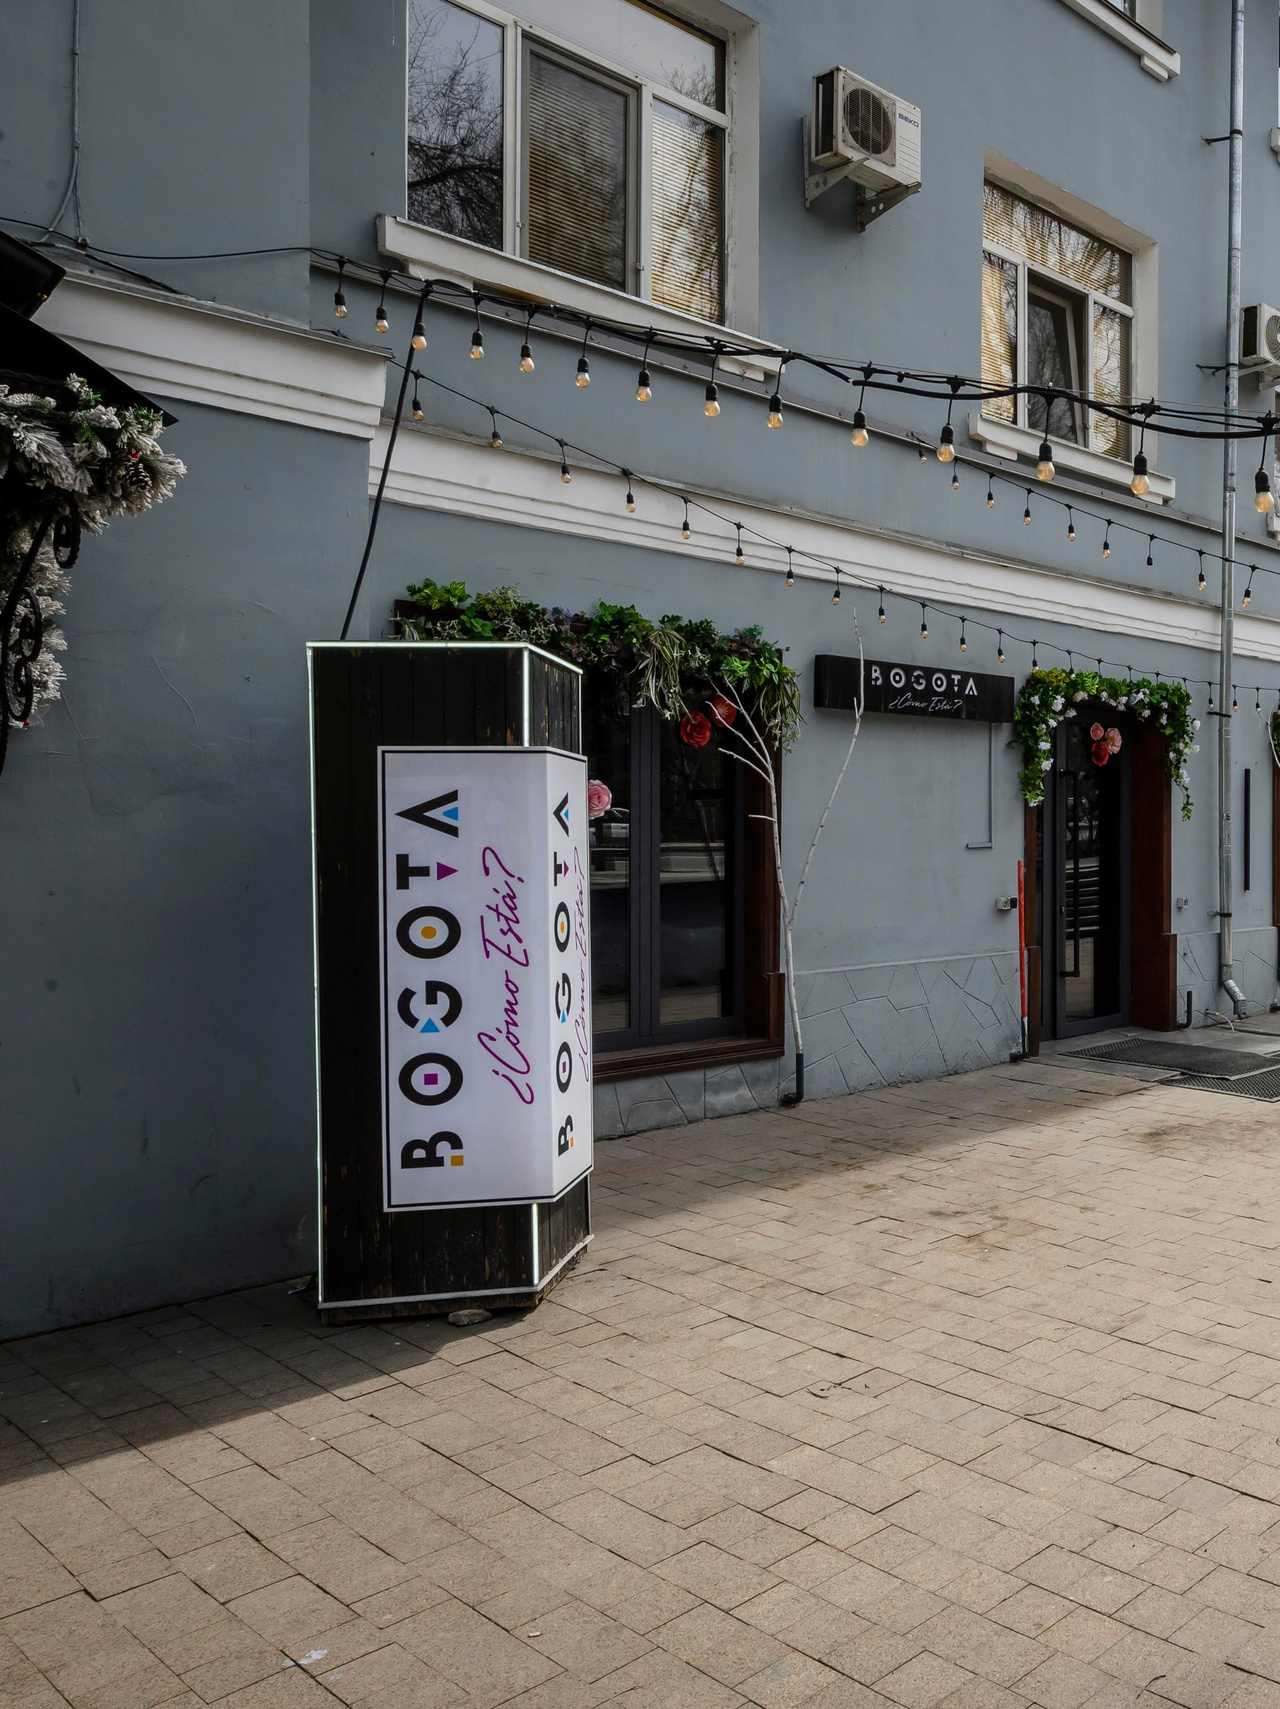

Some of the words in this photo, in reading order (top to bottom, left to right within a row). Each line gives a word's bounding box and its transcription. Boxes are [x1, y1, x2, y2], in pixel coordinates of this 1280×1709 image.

[898, 112, 920, 128] BEKO
[871, 664, 978, 696] BOGOTA
[480, 846, 530, 967] Está?
[394, 789, 464, 1168] BOGOTA
[477, 969, 535, 1105] ¿Cómo
[552, 792, 574, 1156] BOGOTA
